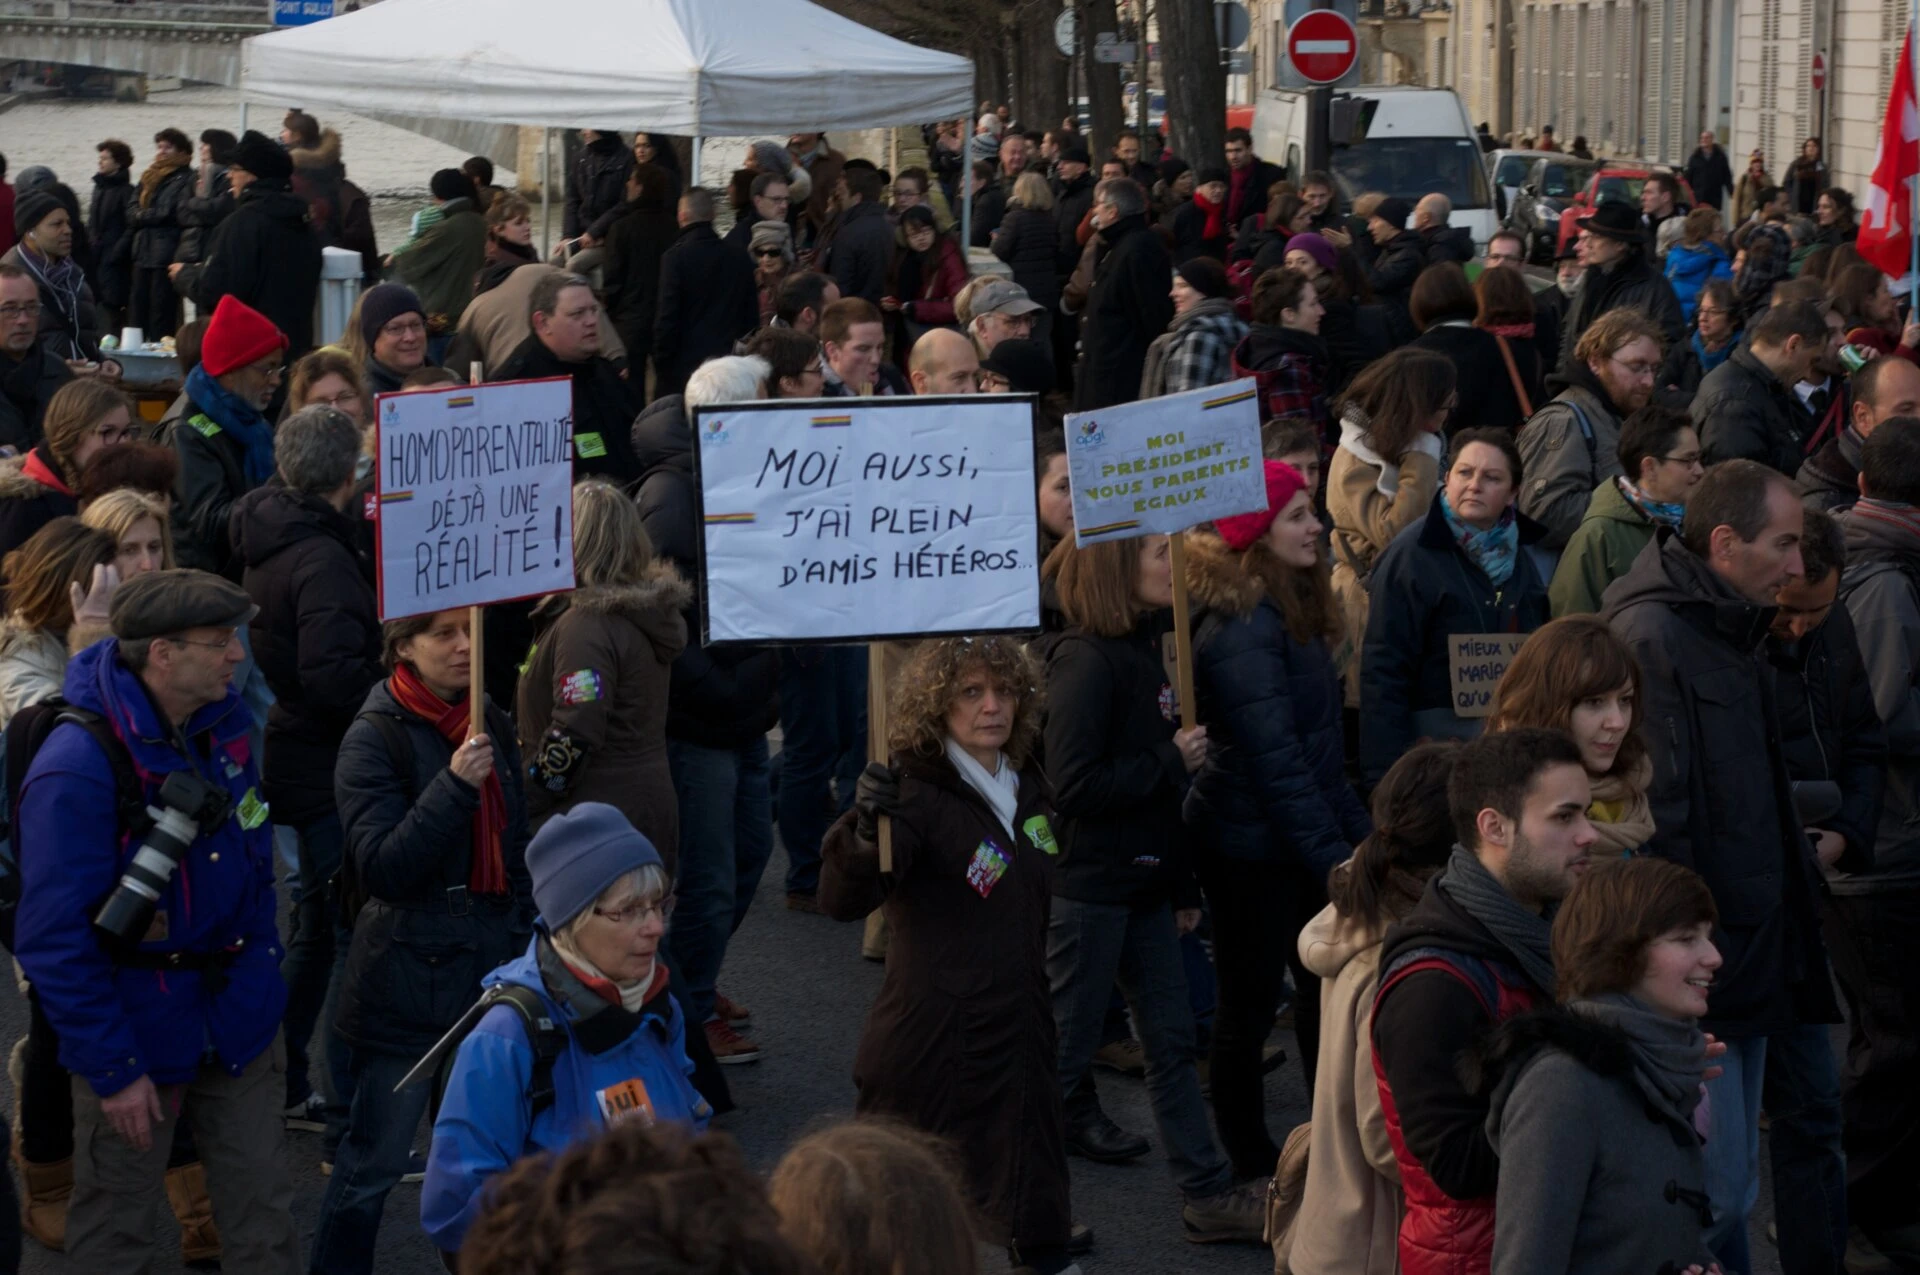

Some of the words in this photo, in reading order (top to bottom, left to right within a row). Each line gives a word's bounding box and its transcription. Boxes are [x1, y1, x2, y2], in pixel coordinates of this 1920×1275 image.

[275, 2, 300, 14] PONT
[1146, 431, 1185, 450] MOI
[1152, 456, 1250, 489] PARENTS
[426, 484, 485, 533] DÉJÀ
[500, 483, 540, 518] UNE
[1458, 661, 1509, 682] MARIA
